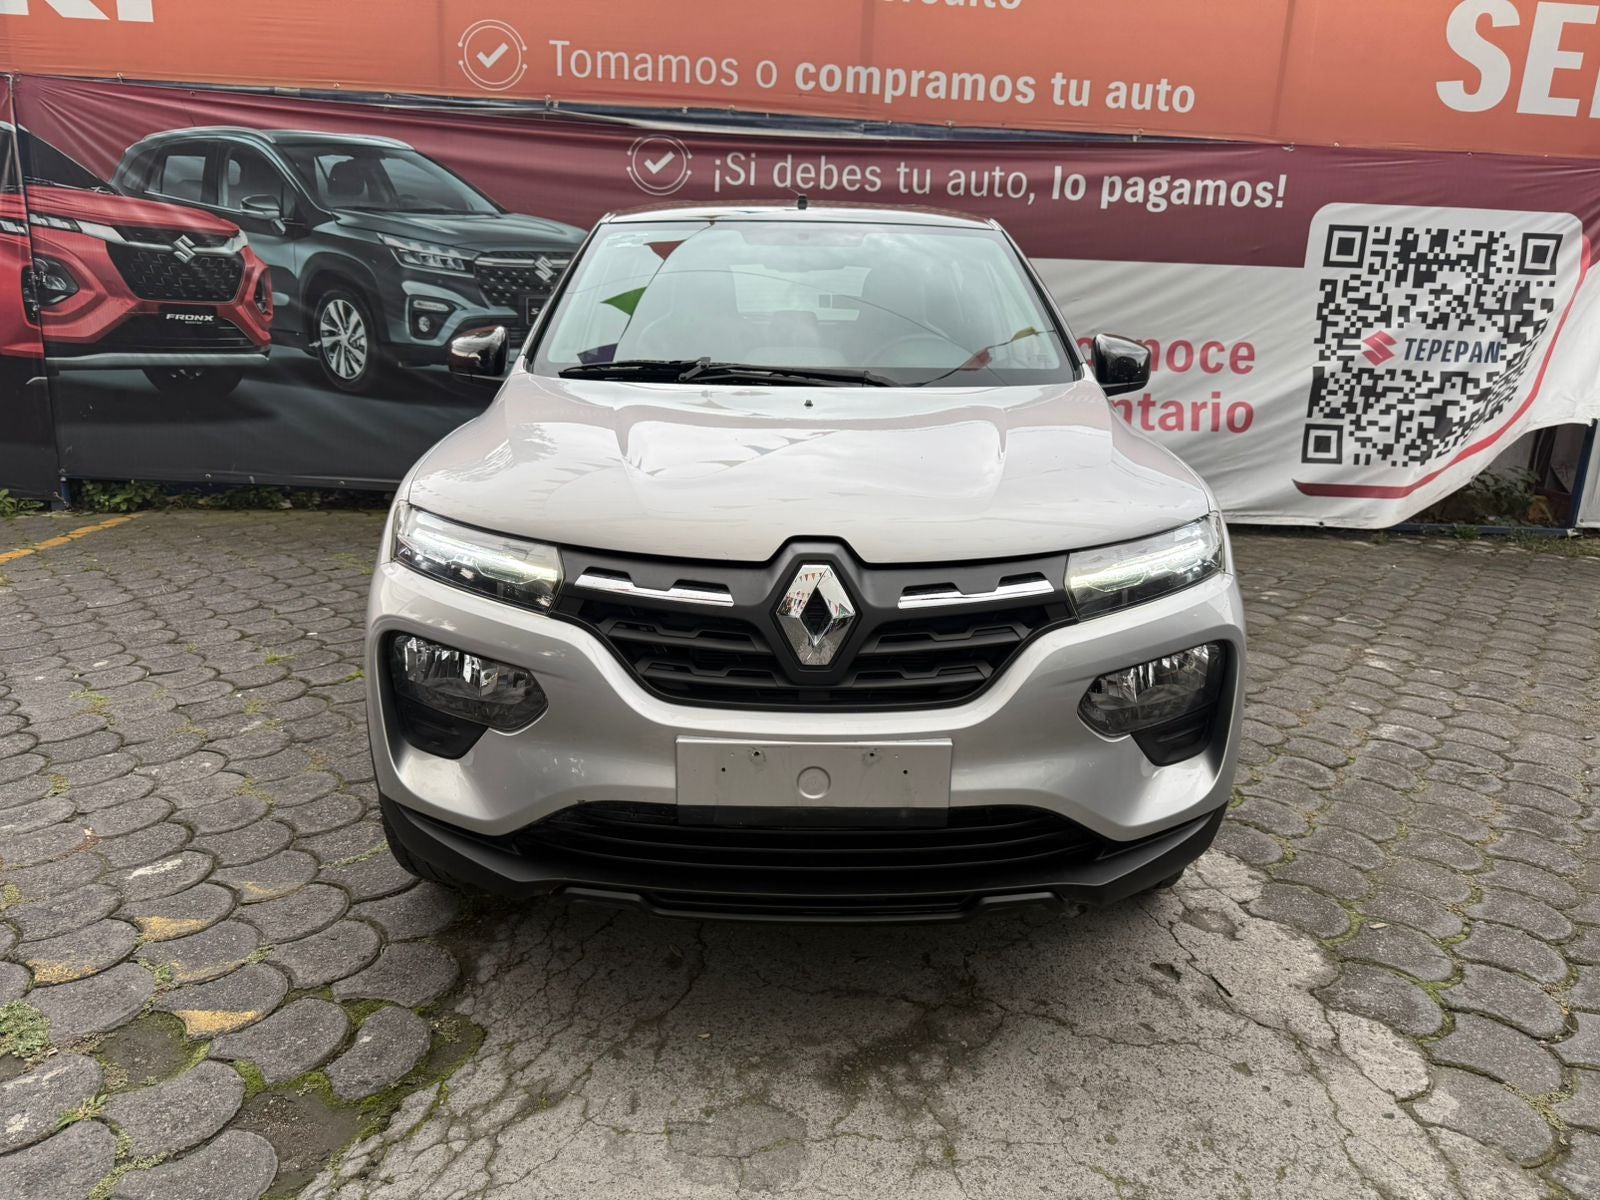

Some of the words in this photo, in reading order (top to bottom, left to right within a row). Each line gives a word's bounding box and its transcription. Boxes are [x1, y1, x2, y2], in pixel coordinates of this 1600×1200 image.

[549, 40, 739, 87] Tomamos
[755, 60, 778, 89] o
[795, 62, 1036, 105] compramos
[1052, 71, 1091, 107] tu
[1105, 79, 1195, 114] auto
[1436, 0, 1600, 119] SE
[713, 152, 757, 193] ¡Si
[772, 154, 882, 193] debes
[897, 165, 932, 195] tu
[946, 167, 1035, 205] auto,
[1052, 166, 1087, 201] lo
[1101, 174, 1287, 212] pagamos!
[165, 313, 214, 321] FRONX
[1404, 338, 1501, 364] TEPEPAN
[1110, 391, 1255, 434] ntario
